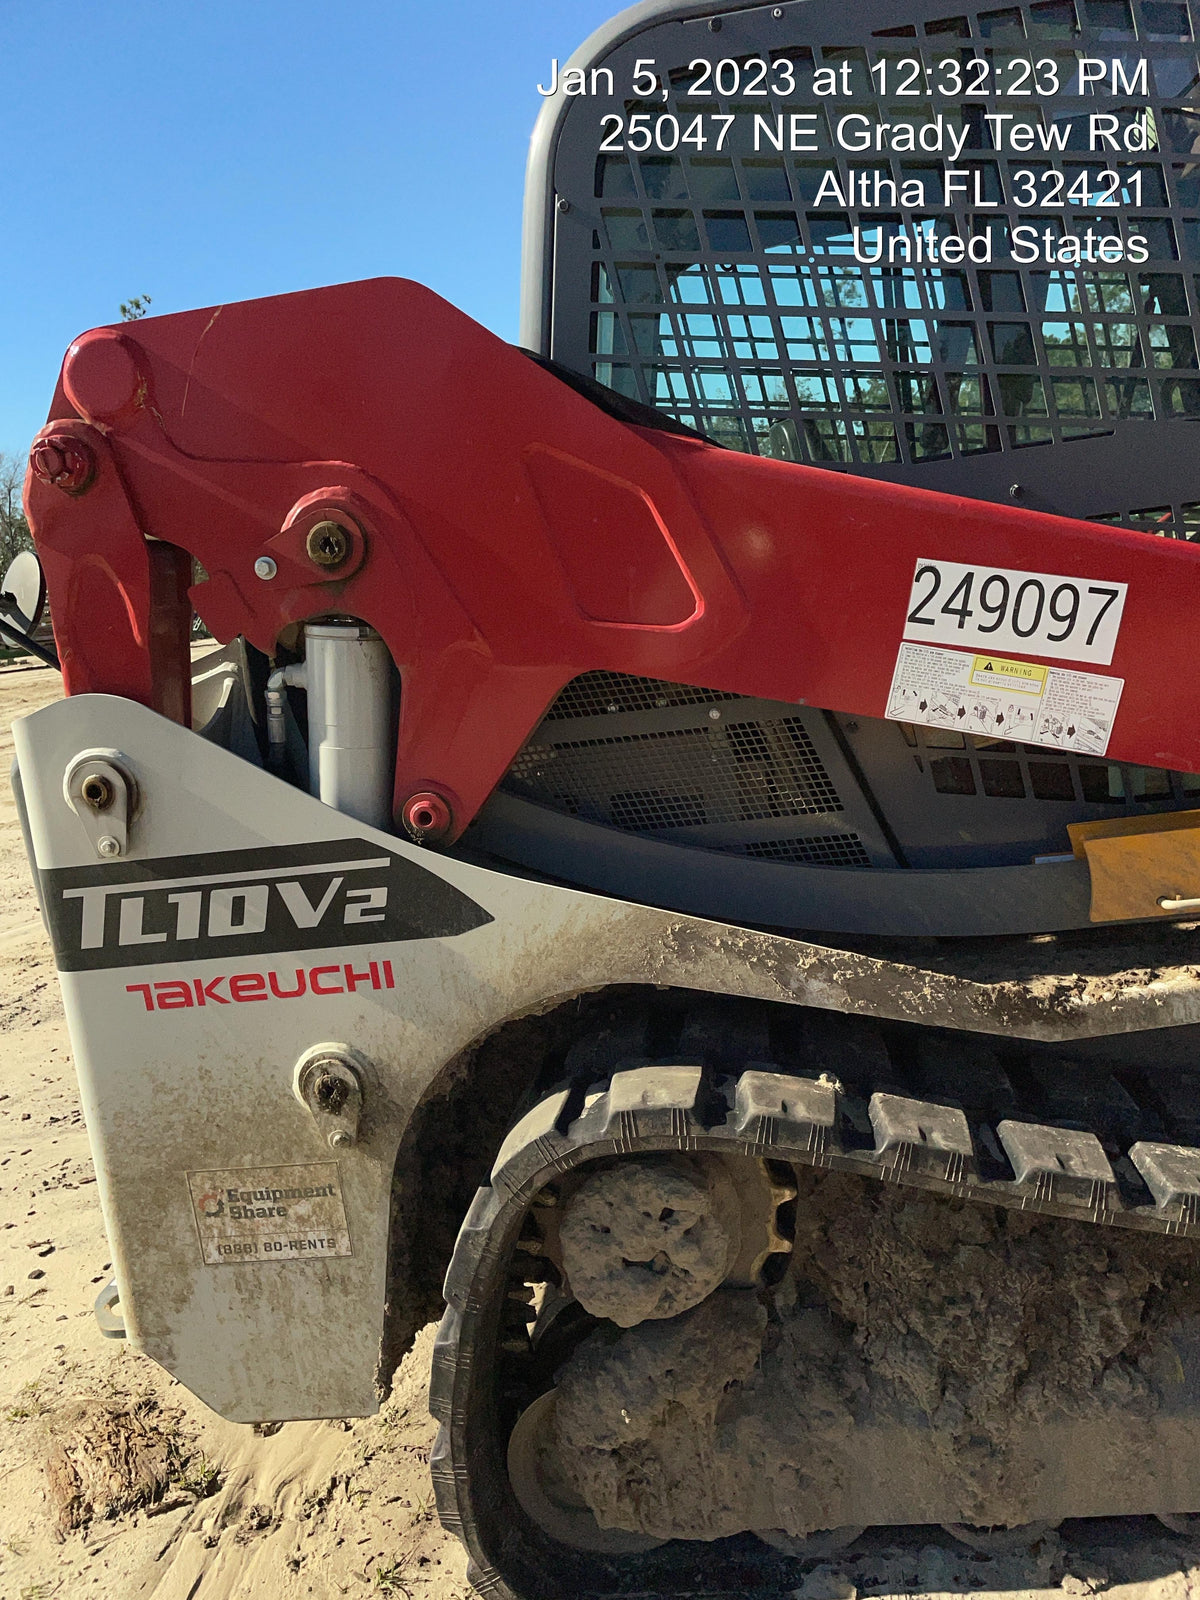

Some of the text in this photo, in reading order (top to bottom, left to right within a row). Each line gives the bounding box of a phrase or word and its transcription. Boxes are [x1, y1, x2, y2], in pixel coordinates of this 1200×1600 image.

[907, 565, 1119, 646] 249097
[999, 665, 1033, 678] WARNING
[62, 856, 391, 950] TL10V2
[225, 1183, 337, 1205] Equipment
[228, 1205, 288, 1220] Share
[217, 1238, 337, 1256] (888) 80-RENTS
